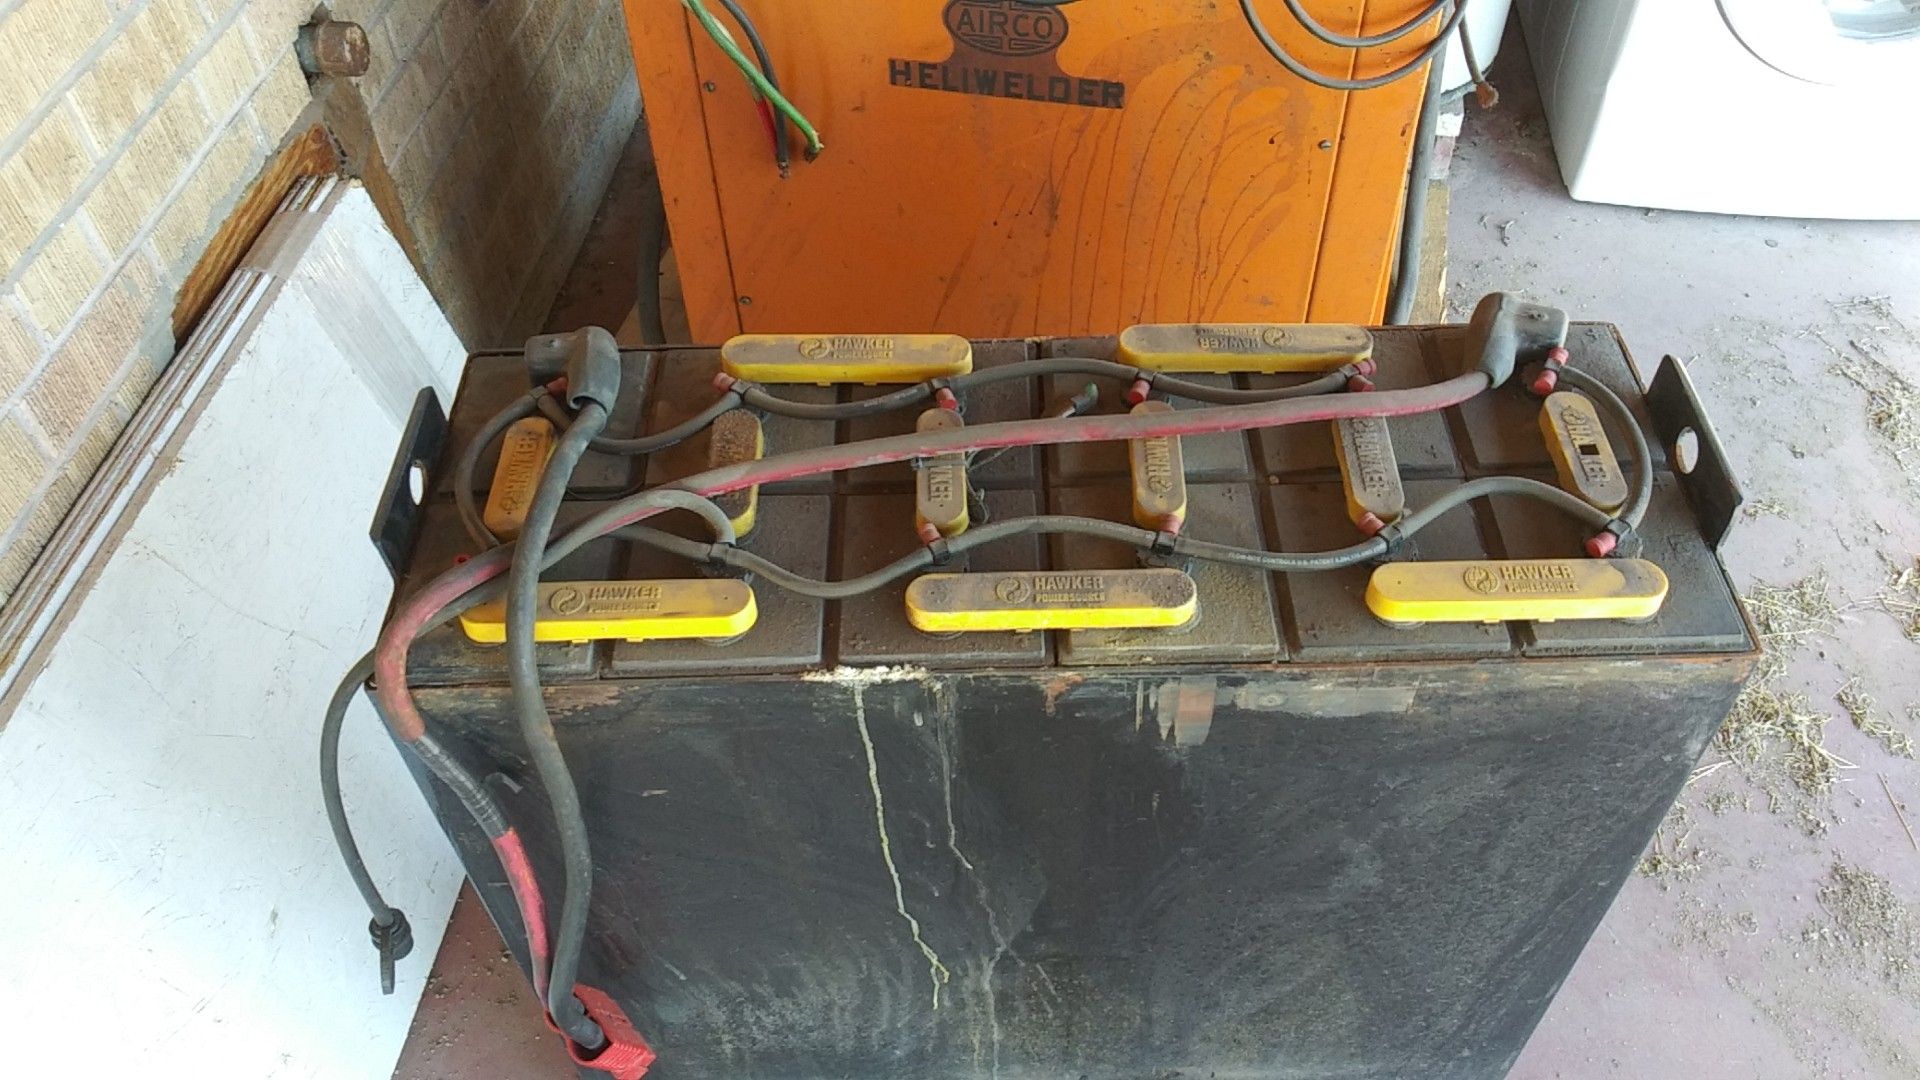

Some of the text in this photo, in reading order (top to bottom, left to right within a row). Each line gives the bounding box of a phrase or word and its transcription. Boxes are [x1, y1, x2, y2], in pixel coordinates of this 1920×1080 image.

[956, 8, 1054, 40] AIRCO
[888, 57, 1126, 109] HELIWELDER
[831, 338, 894, 350] HAWKER
[1198, 336, 1261, 350] HAWKER
[1565, 421, 1611, 482] HAKER
[1352, 427, 1390, 492] HAWKER
[1499, 565, 1574, 579] HAWKER
[1033, 575, 1104, 590] HAWKER
[589, 586, 662, 600] HAWKER
